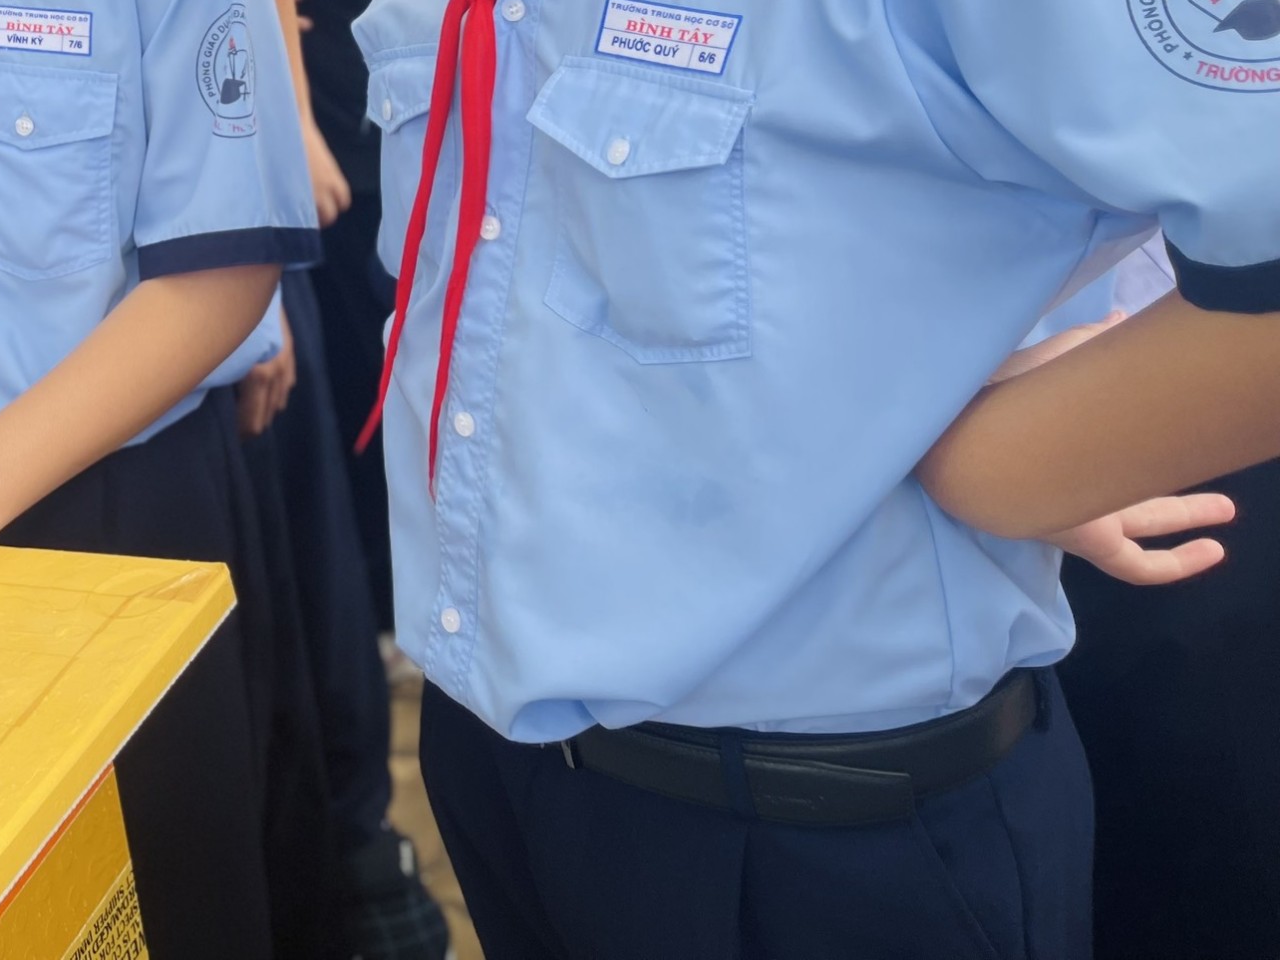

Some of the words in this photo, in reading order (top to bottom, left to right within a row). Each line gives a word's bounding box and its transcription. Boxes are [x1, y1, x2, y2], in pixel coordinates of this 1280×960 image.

[611, 2, 648, 15] TRƯỜNG
[651, 9, 682, 21] TRUNG
[684, 15, 704, 25] HỌC
[705, 18, 721, 27] CƠ
[6, 19, 43, 34] BÌNH
[47, 23, 75, 35] TÂY
[625, 18, 673, 38] BÌNH
[678, 27, 715, 44] TÂY
[7, 33, 29, 44] VĨNH
[69, 40, 83, 49] 7/6
[611, 36, 652, 53] PHƯỚC
[653, 44, 680, 58] QUÝ
[698, 51, 717, 64] 6/6
[1195, 59, 1280, 84] TRƯỜNG
[93, 884, 125, 935] SHIPPER
